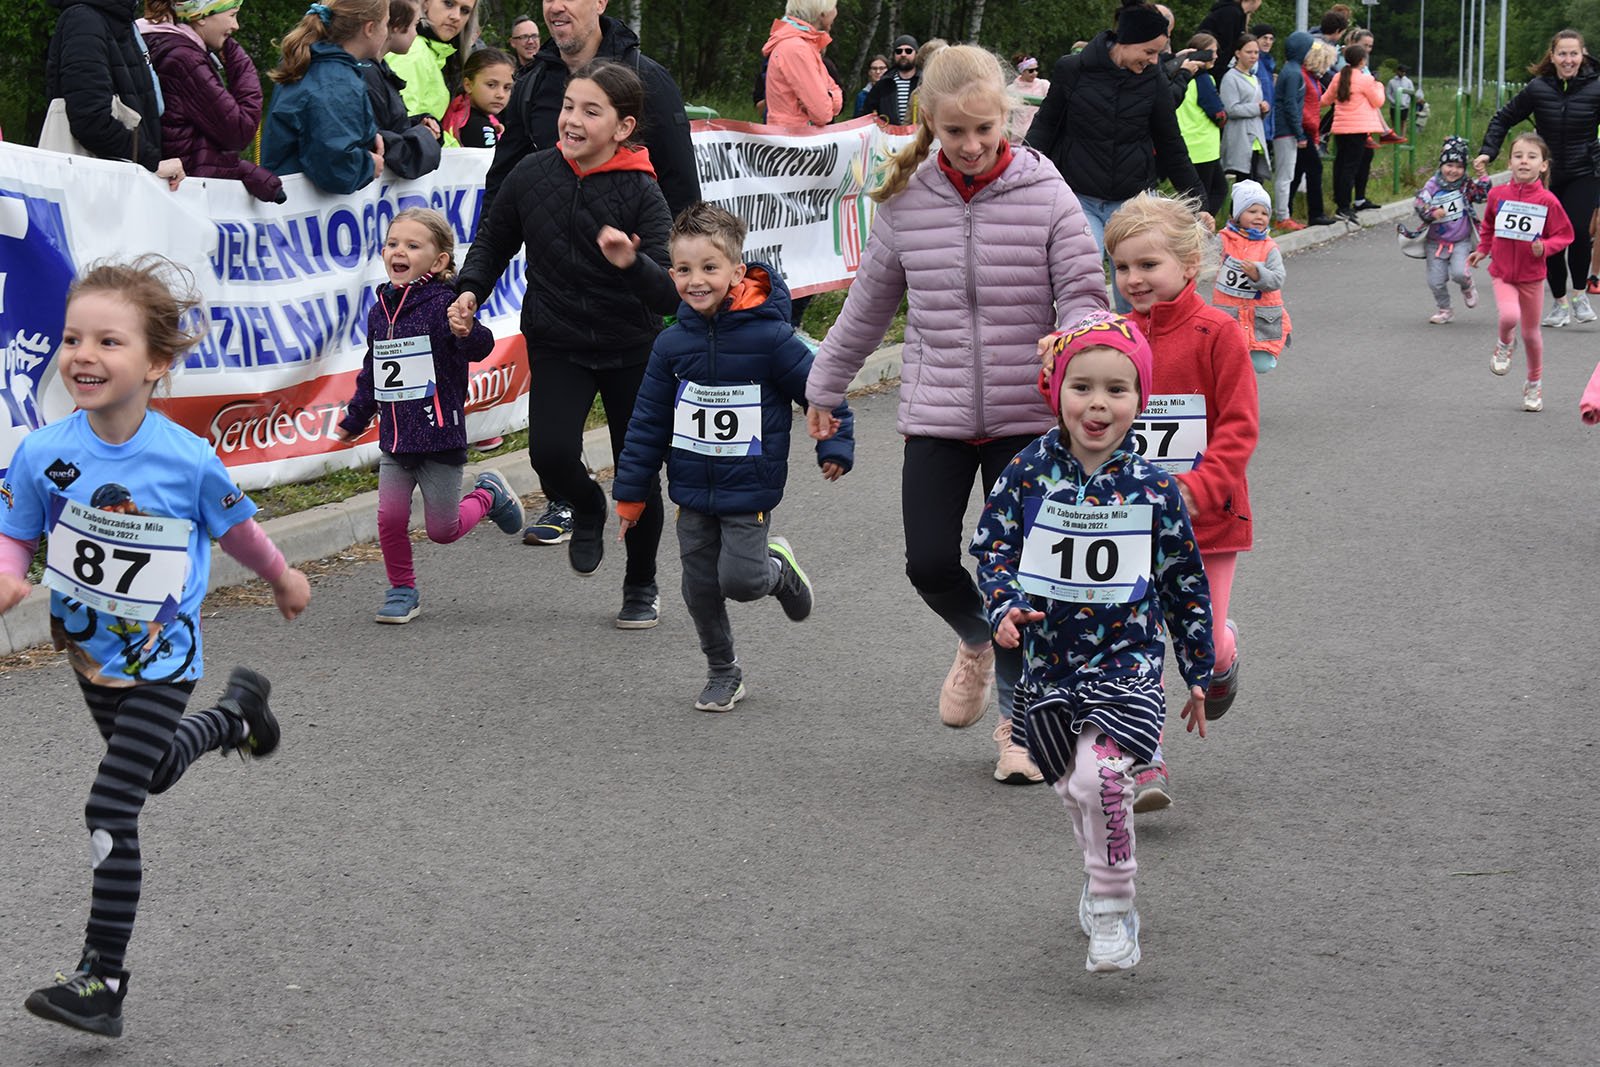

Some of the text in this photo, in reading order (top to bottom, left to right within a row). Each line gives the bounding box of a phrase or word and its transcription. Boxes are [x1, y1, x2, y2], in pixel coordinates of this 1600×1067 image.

[1504, 214, 1532, 232] 56
[1226, 270, 1251, 290] 92
[382, 361, 403, 388] 2
[210, 402, 346, 454] Serdecz
[692, 408, 739, 441] 19
[1132, 422, 1179, 457] 57
[70, 505, 163, 532] VII Zabobrzańska Mila
[1046, 505, 1128, 520] VII Zabobrzańska Mila
[88, 523, 97, 531] 28
[97, 527, 116, 537] maja
[116, 530, 134, 540] 2022
[73, 539, 151, 594] 87
[1051, 537, 1119, 582] 10
